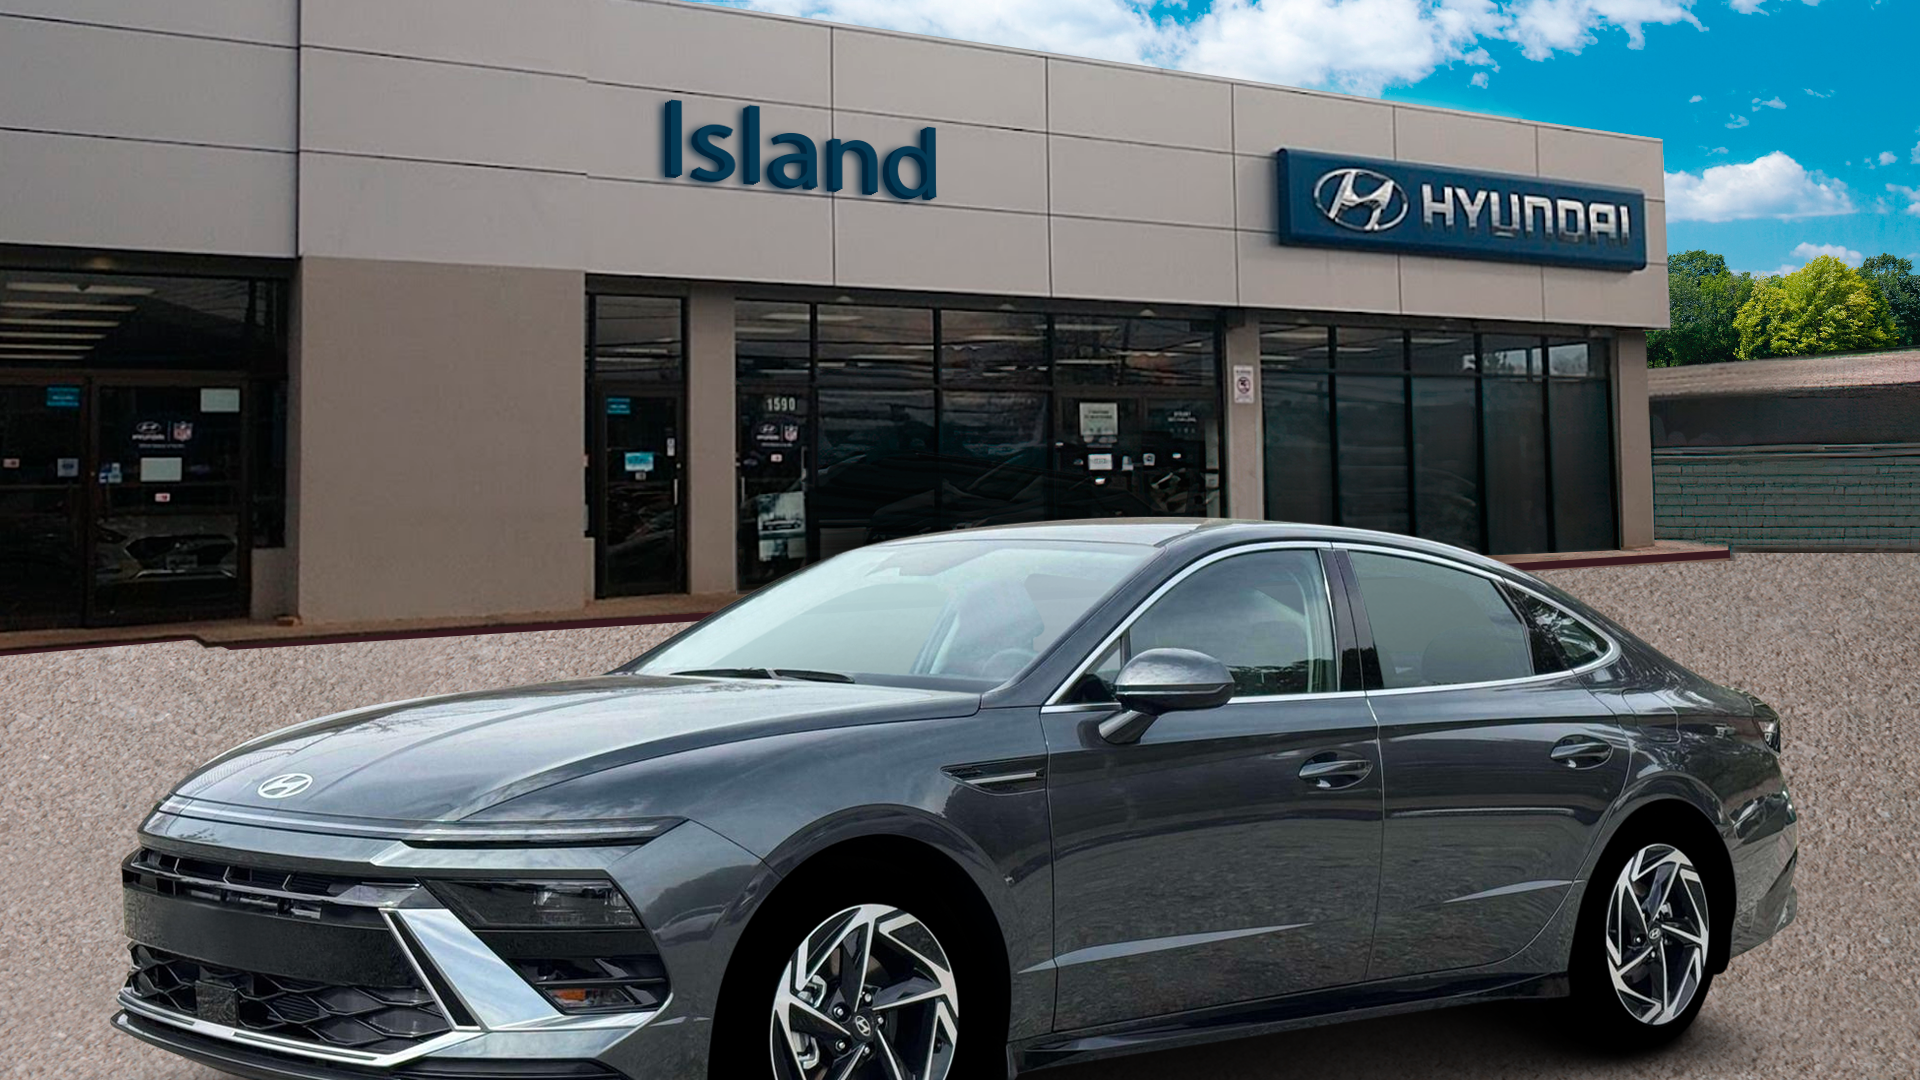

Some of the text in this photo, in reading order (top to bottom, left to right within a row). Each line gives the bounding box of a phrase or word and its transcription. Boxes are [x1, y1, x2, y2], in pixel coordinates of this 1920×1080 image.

[664, 99, 936, 200] Island
[1421, 184, 1631, 244] HYUNDAI
[767, 397, 796, 411] 1590
